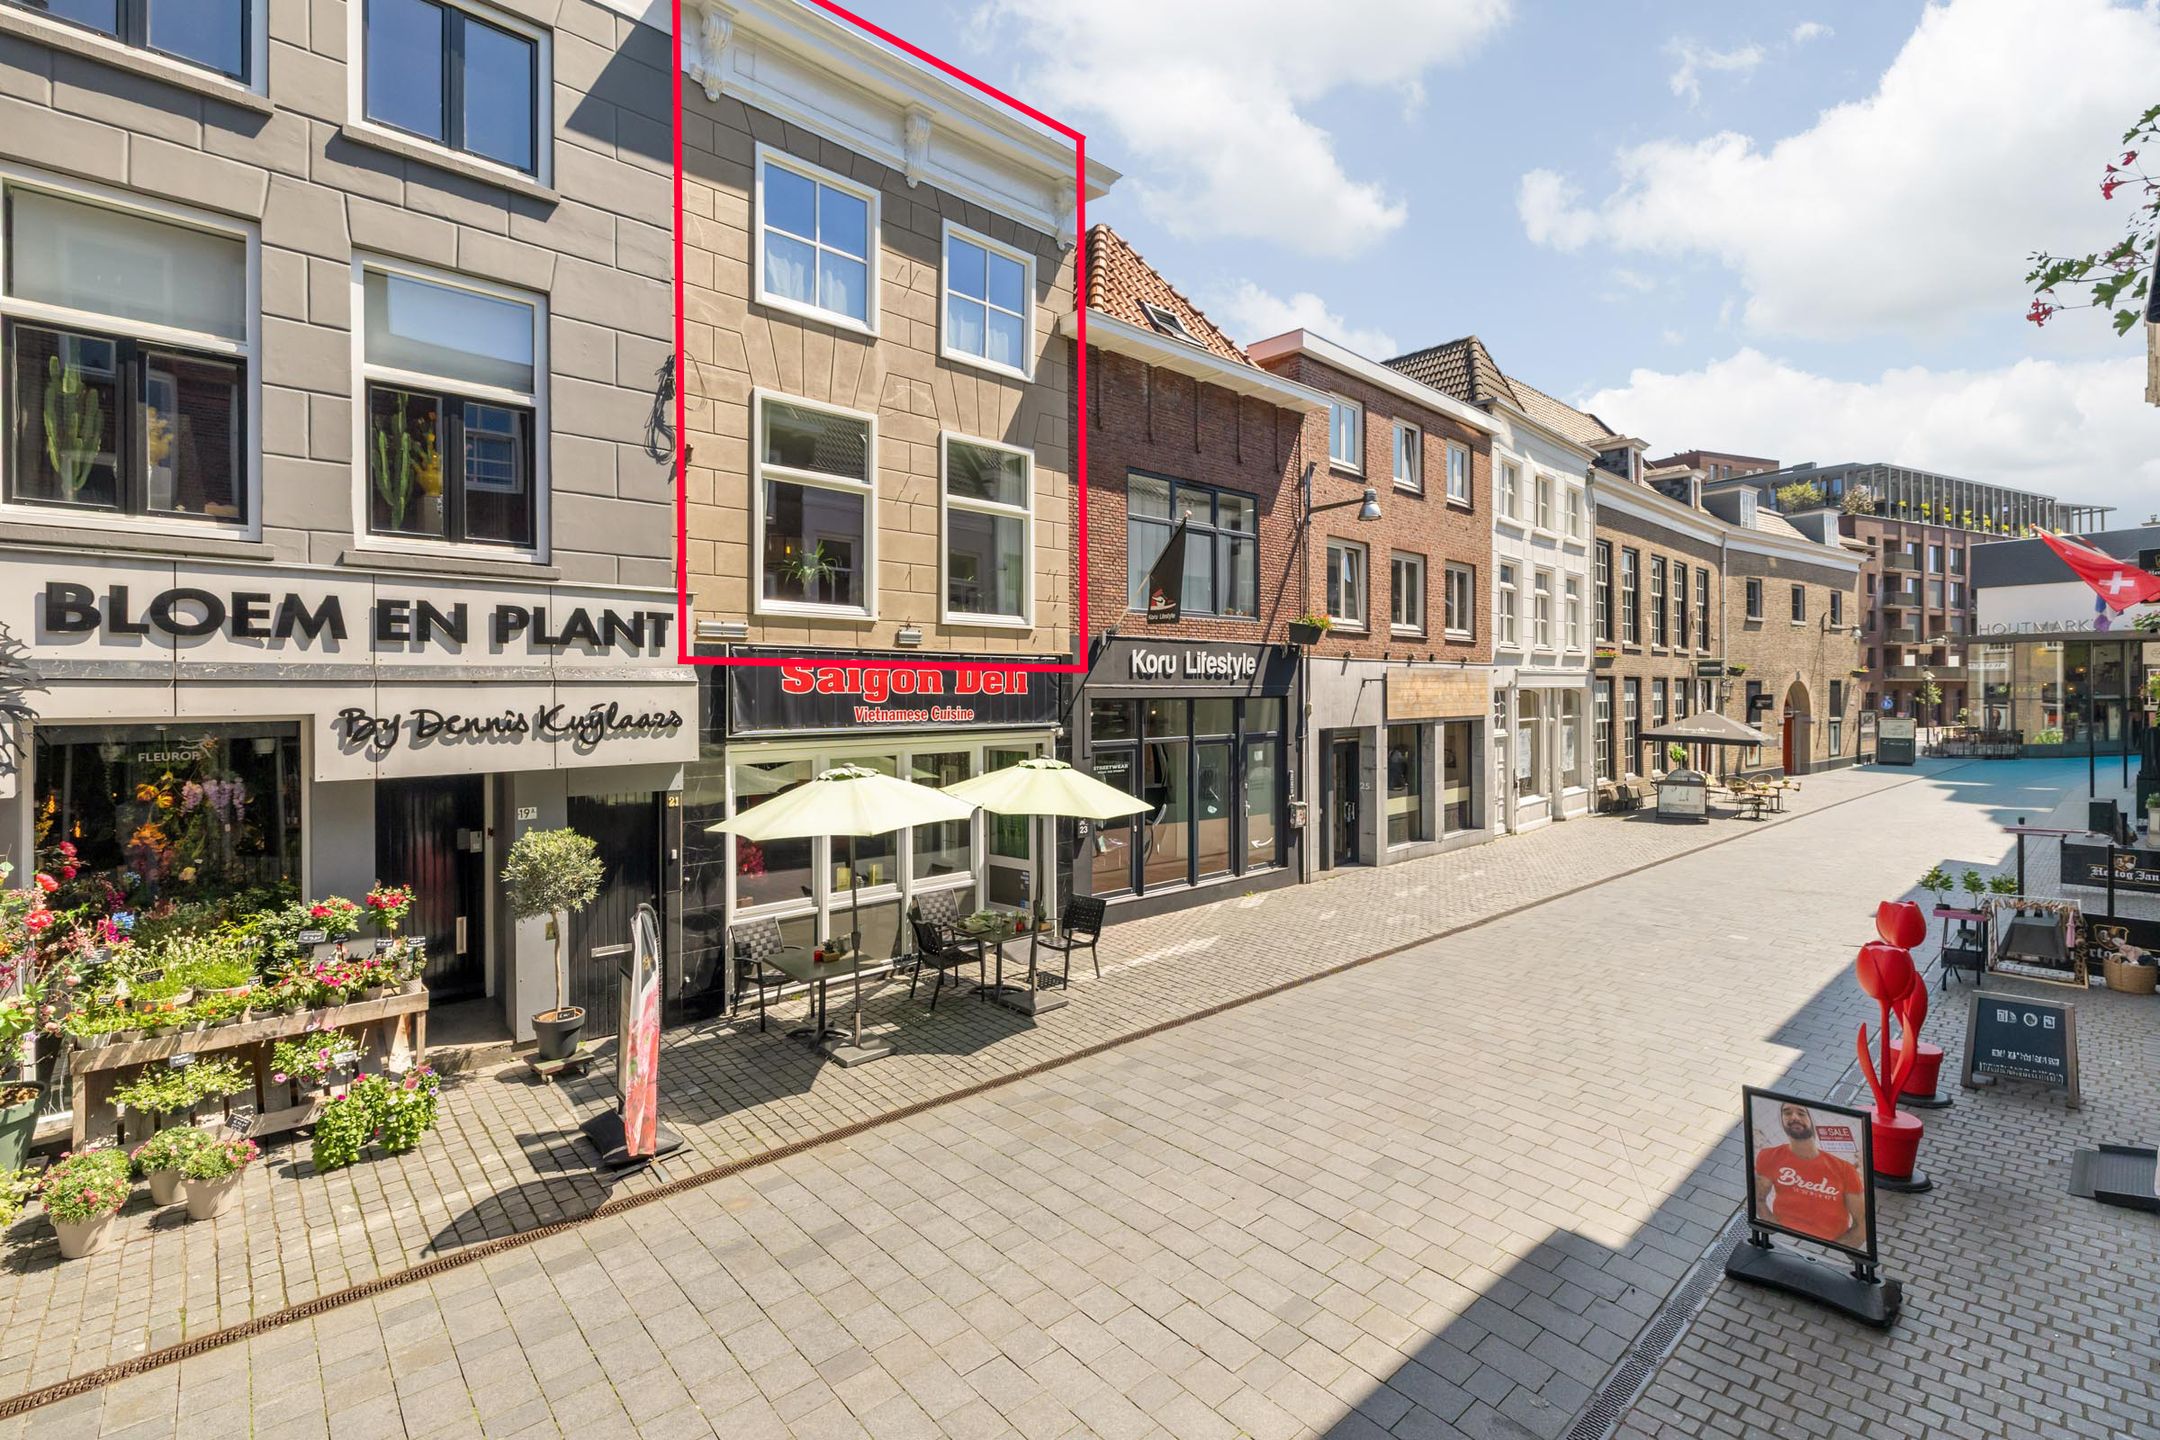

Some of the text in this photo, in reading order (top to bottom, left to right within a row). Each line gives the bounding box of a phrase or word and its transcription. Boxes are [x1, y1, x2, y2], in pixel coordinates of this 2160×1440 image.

[45, 581, 674, 648] BLOEM EN PLANT
[1978, 619, 2094, 636] HOUTMARK
[1131, 650, 1257, 680] Koru Lifestyle
[781, 660, 1028, 703] Saigon Deli
[853, 705, 975, 723] Vietnamese Cuisine
[338, 707, 401, 749] By
[410, 708, 530, 738] Dennis
[138, 751, 201, 762] FLEUROP
[1360, 782, 1370, 790] 25
[668, 796, 679, 807] 21
[1079, 825, 1088, 834] 23
[1827, 1127, 1850, 1137] SALE
[1777, 1167, 1839, 1196] Breda
